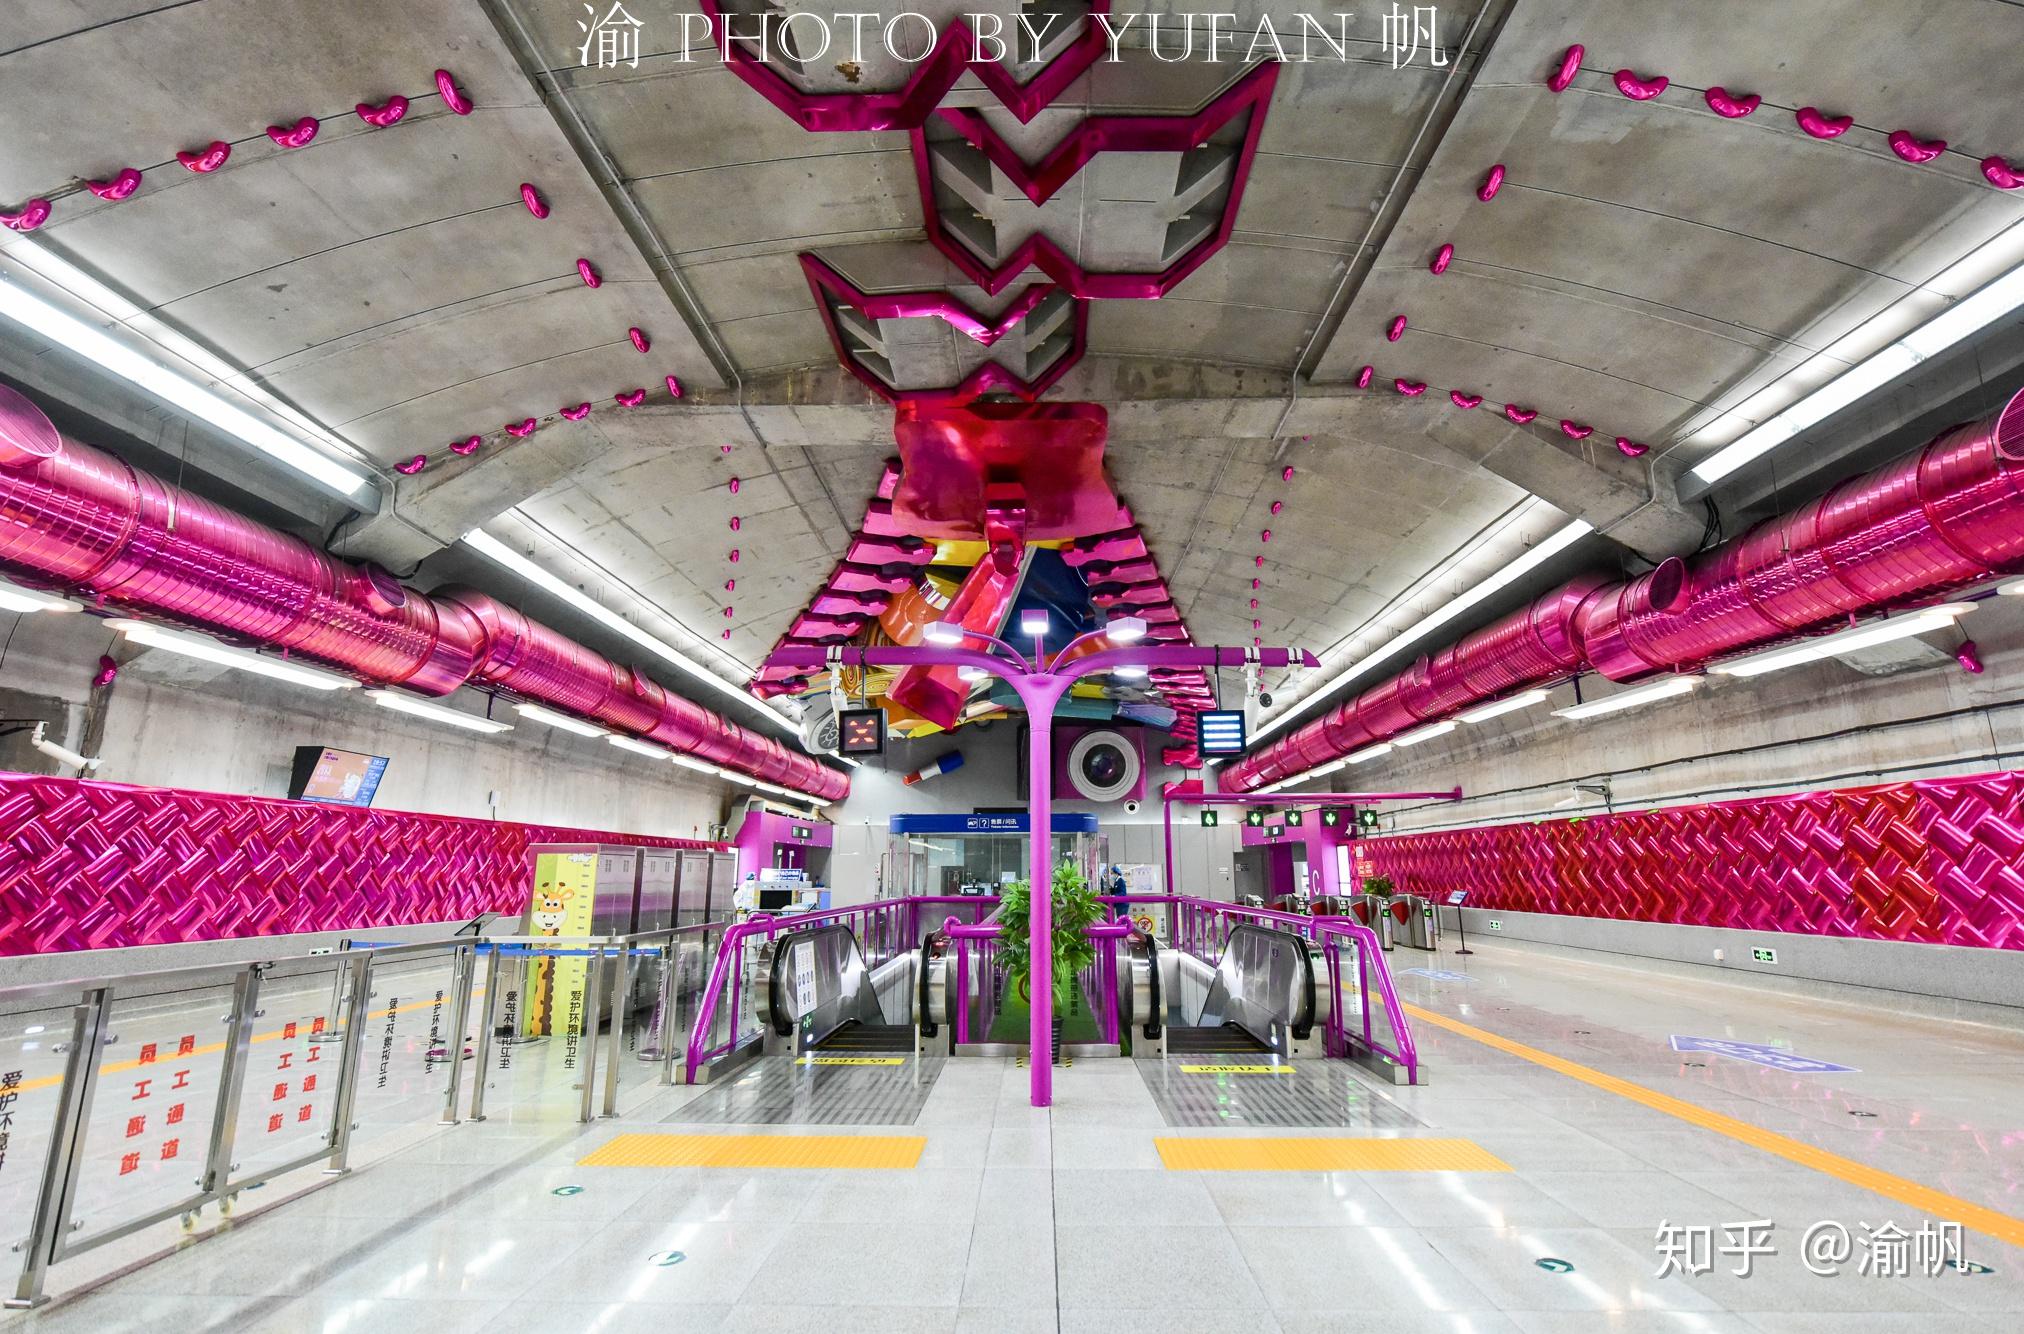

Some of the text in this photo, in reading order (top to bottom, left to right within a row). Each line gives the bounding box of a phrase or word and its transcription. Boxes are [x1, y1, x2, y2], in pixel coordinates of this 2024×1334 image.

[298, 1016, 325, 1122] 员工通道
[564, 990, 582, 1069] 爱护环境讲卫生
[160, 1034, 196, 1161] 员工通道
